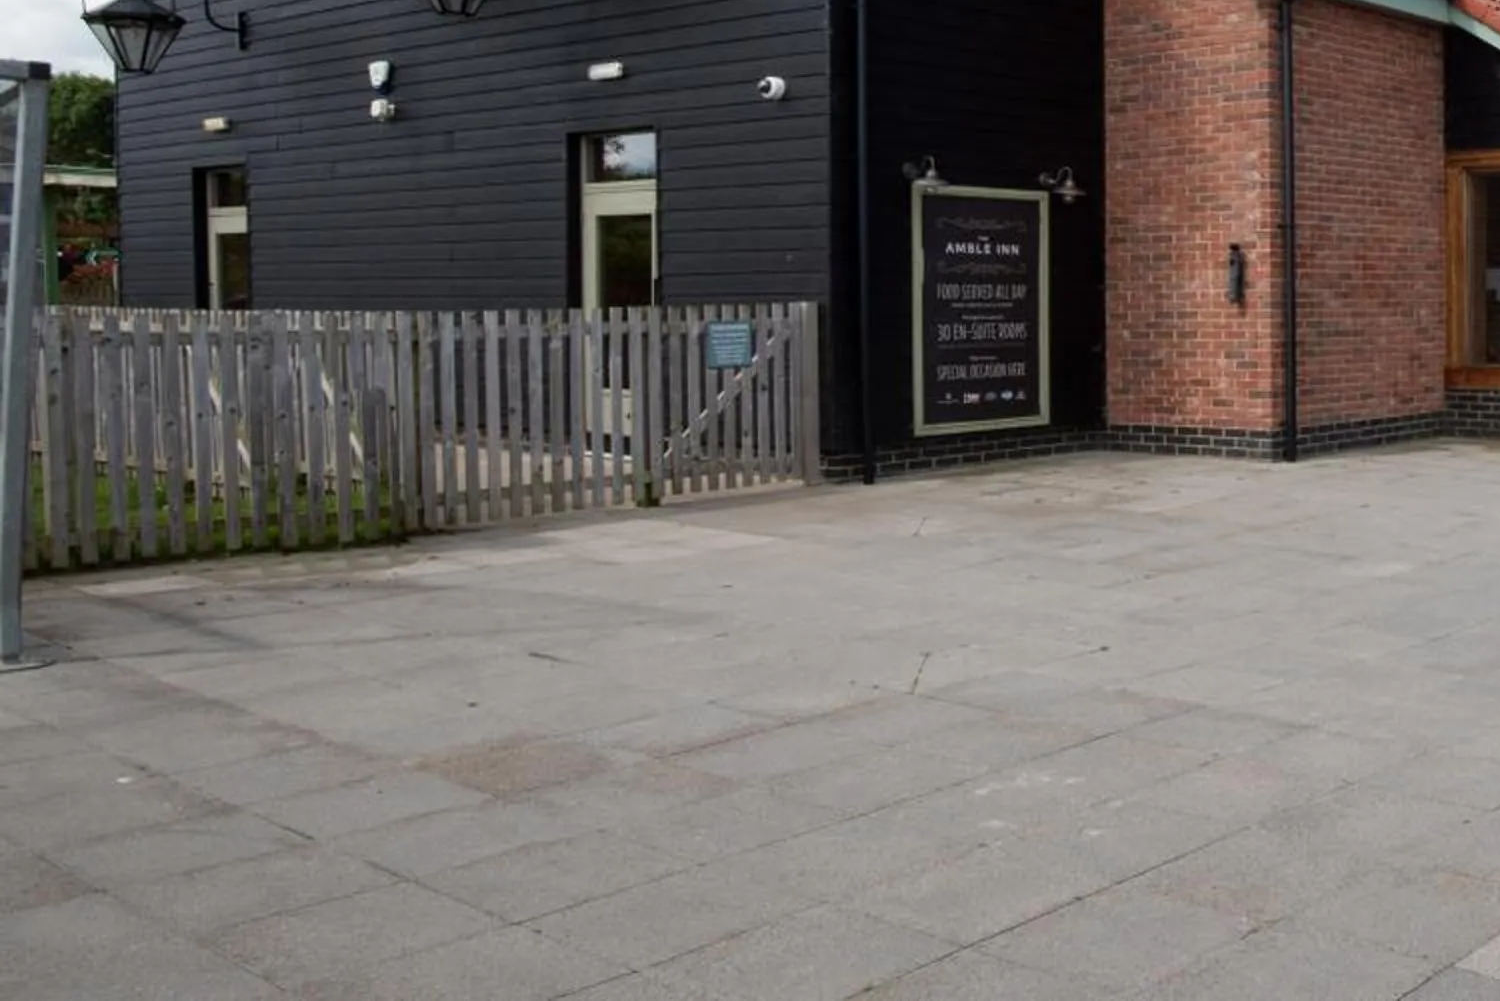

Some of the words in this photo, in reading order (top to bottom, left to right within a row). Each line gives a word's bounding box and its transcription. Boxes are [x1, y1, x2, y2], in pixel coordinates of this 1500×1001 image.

[945, 241, 991, 255] AMBLE
[996, 243, 1020, 256] INN
[962, 283, 994, 300] SERVED
[995, 283, 1010, 299] ALL
[937, 323, 951, 342] 30
[953, 322, 996, 341] EN-SUITE
[998, 321, 1027, 340] ROOMS
[937, 365, 967, 382] SPECIAL
